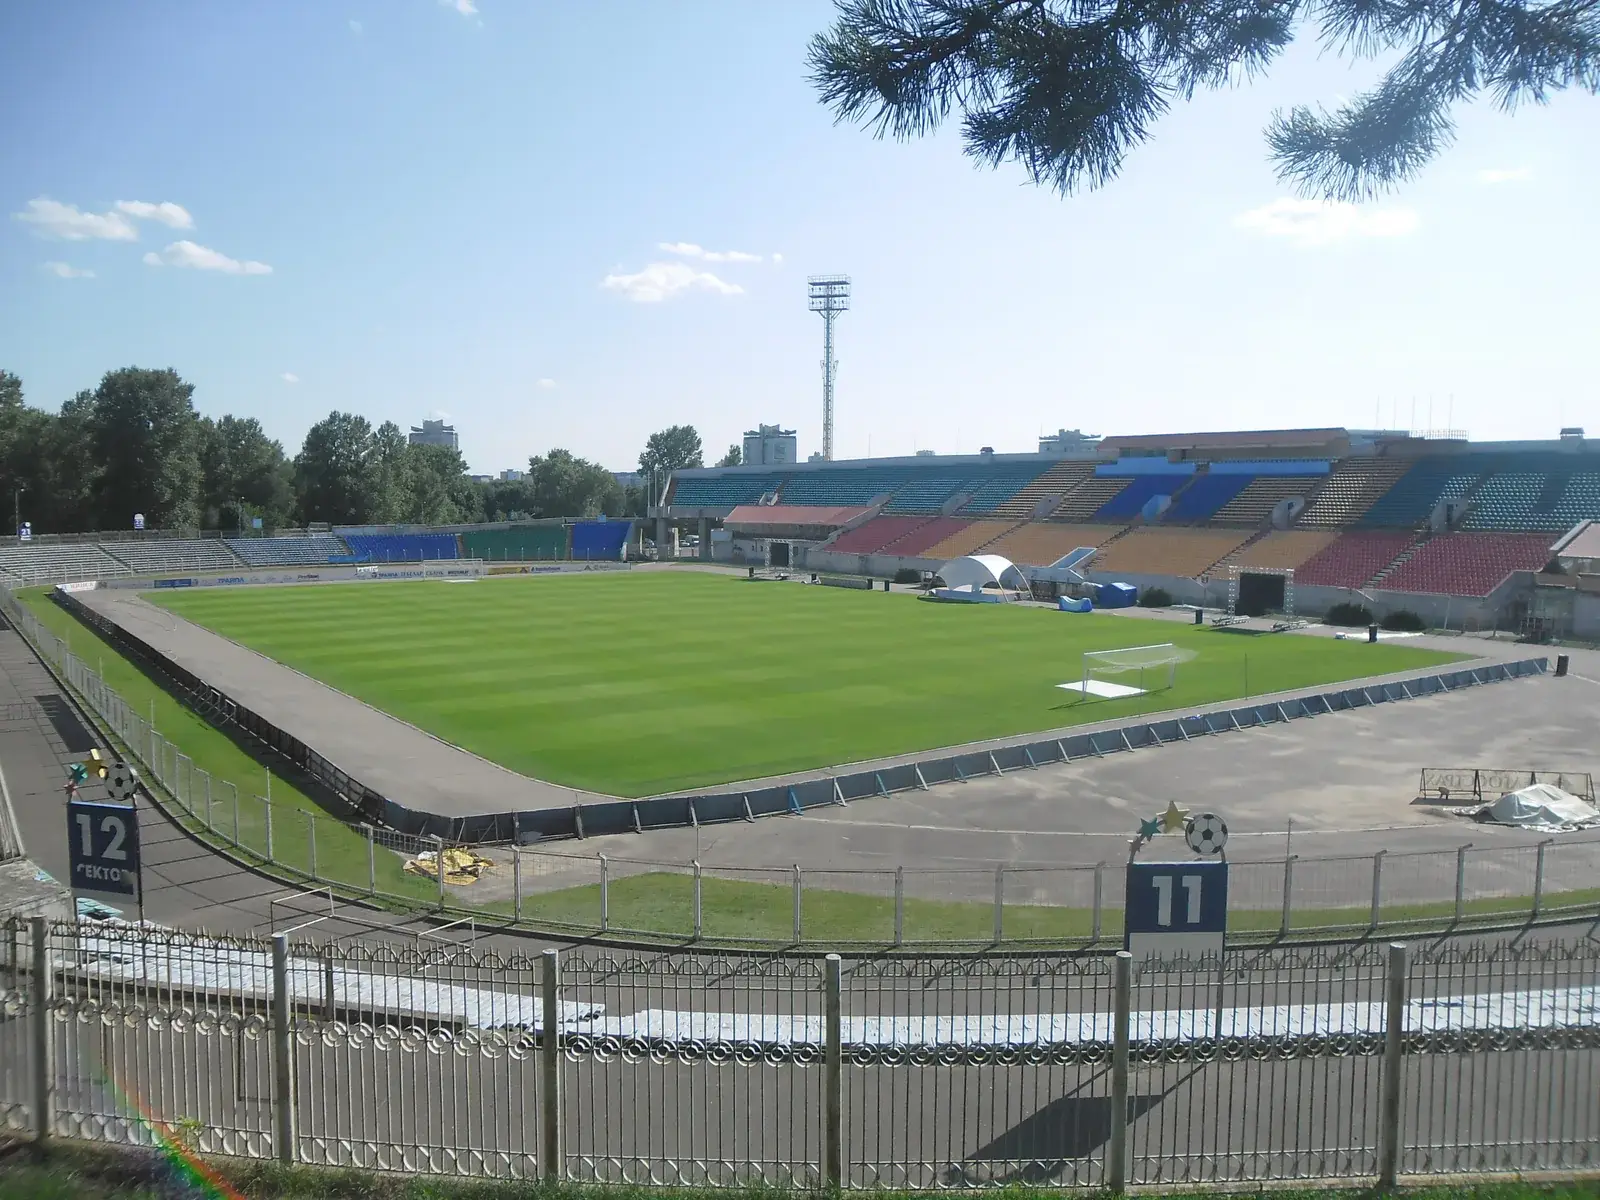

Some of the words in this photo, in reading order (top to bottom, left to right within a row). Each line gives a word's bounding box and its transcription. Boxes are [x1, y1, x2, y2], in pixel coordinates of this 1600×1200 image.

[21, 528, 31, 536] 21
[76, 813, 127, 860] 12
[76, 863, 129, 882] СЕКТО
[1152, 875, 1202, 927] 11
